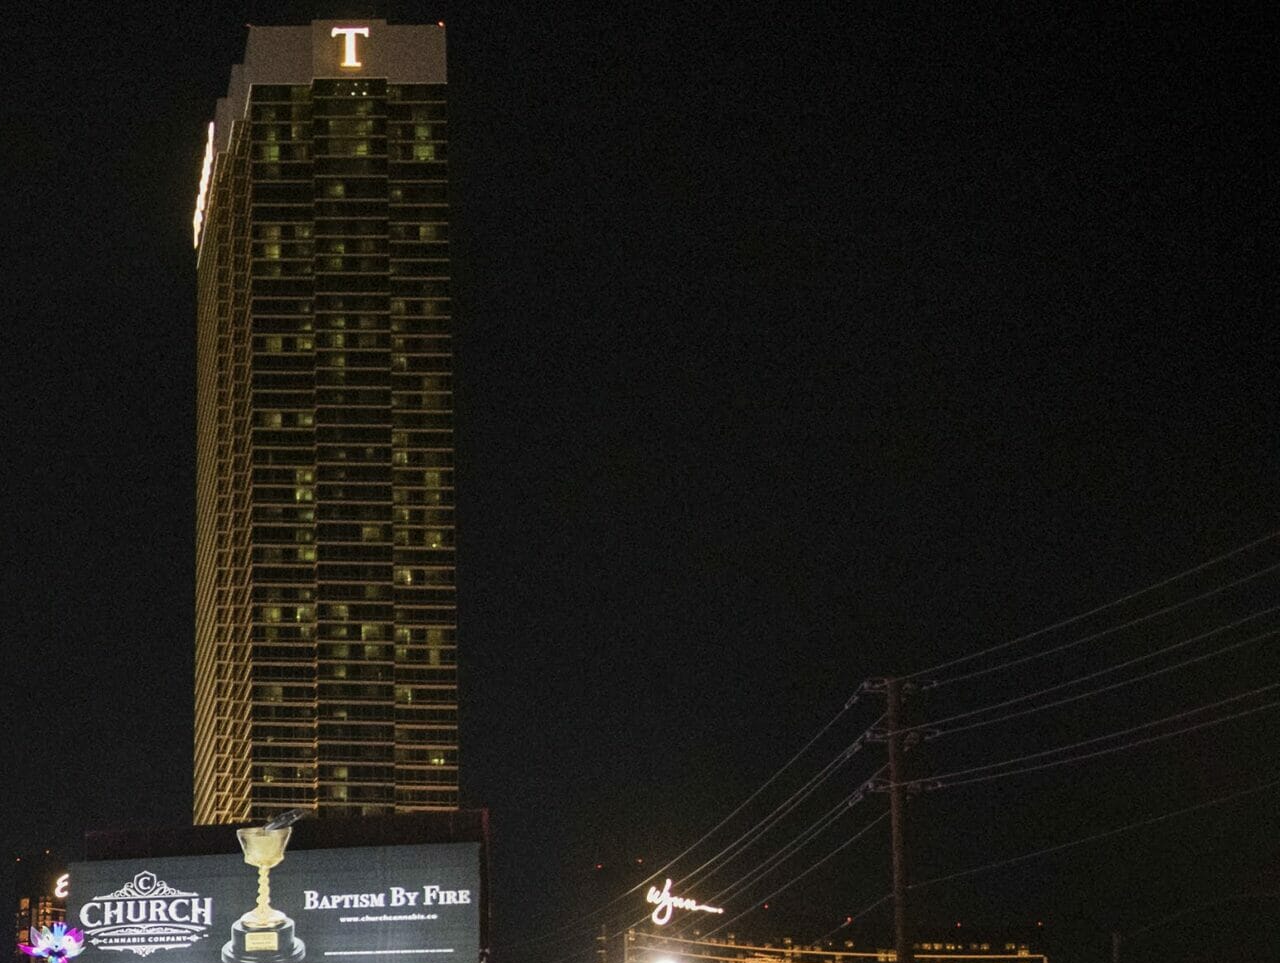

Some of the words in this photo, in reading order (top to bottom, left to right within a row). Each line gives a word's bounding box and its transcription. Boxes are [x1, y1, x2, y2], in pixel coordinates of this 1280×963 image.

[331, 27, 369, 67] T
[79, 897, 213, 928] CHURCH
[102, 936, 146, 944] CANNABIS
[148, 935, 188, 943] COMPANY
